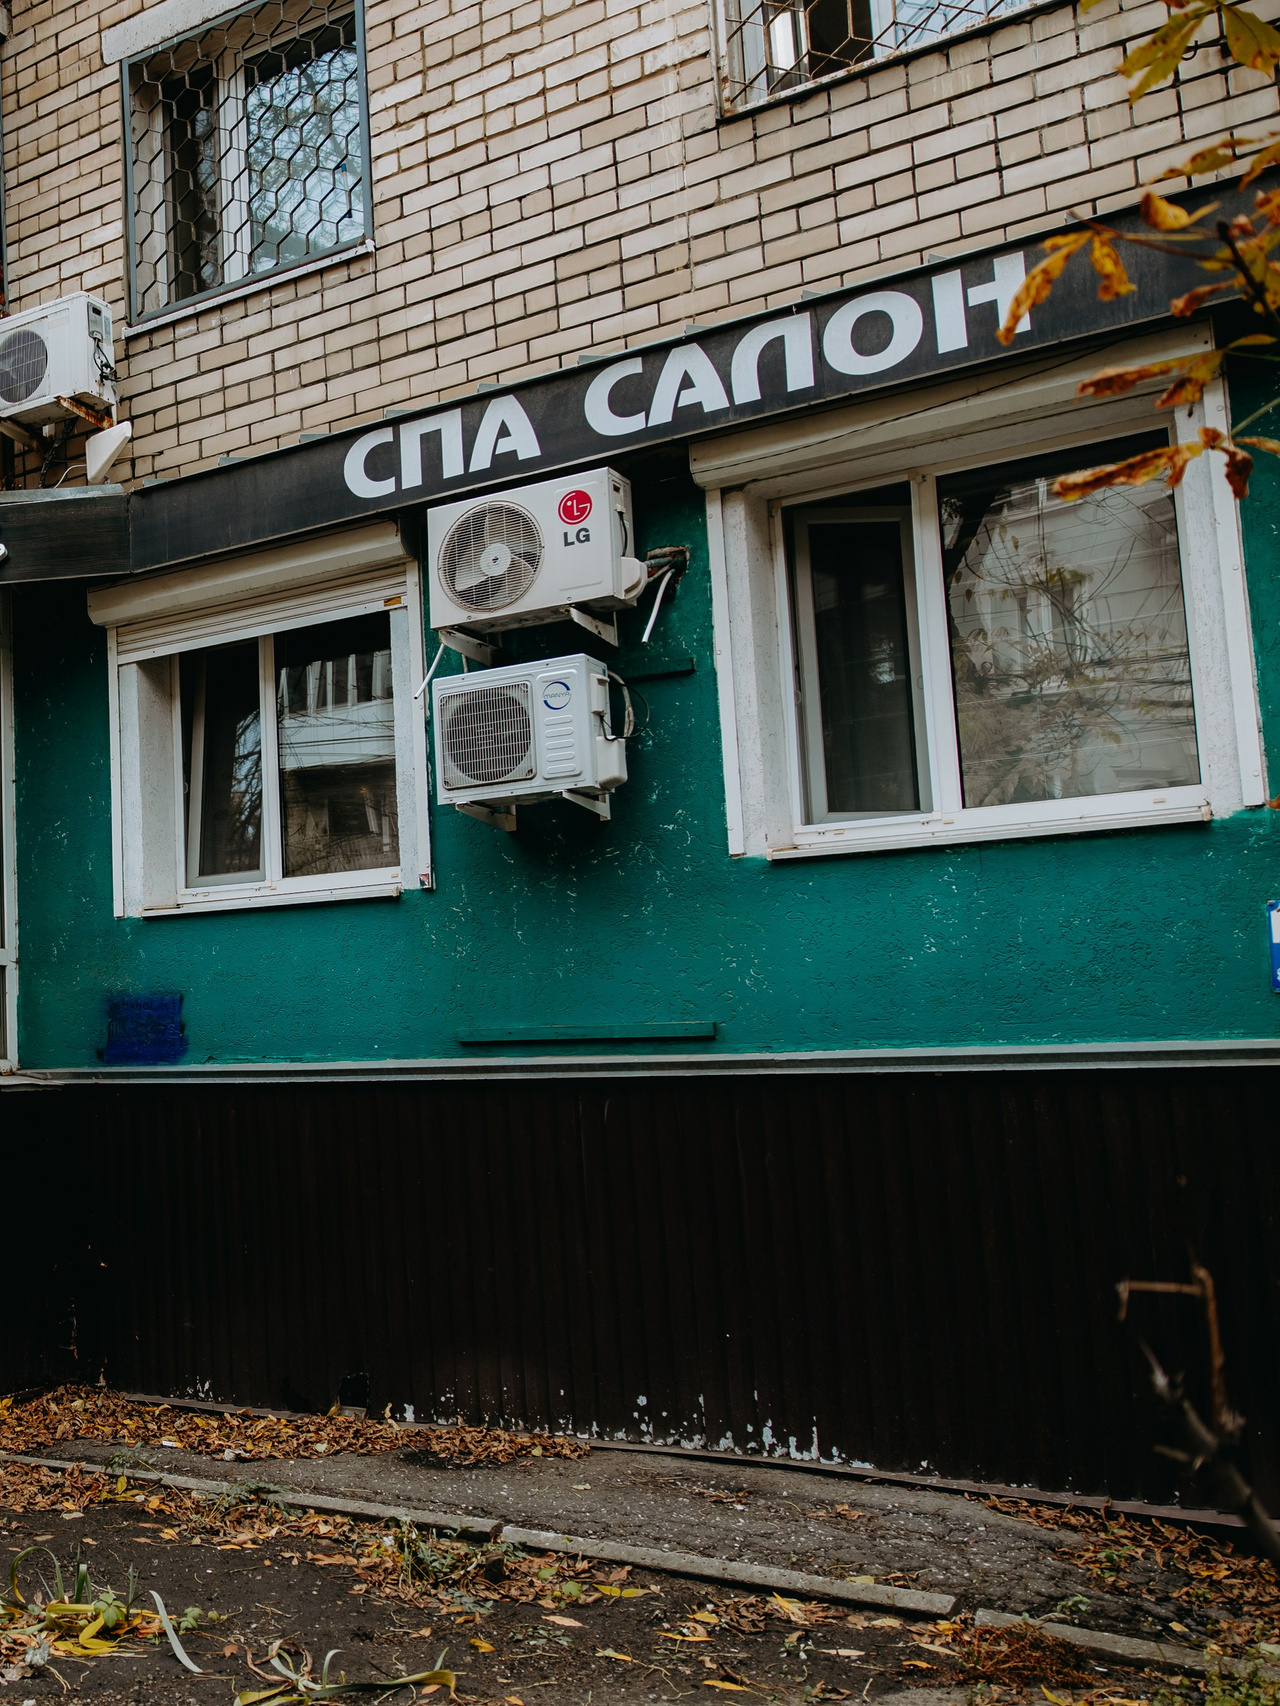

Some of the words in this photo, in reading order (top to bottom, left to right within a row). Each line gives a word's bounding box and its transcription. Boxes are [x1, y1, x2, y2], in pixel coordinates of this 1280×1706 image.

[343, 396, 542, 499] СПА
[583, 250, 1031, 437] САЛОН
[563, 527, 590, 547] LG
